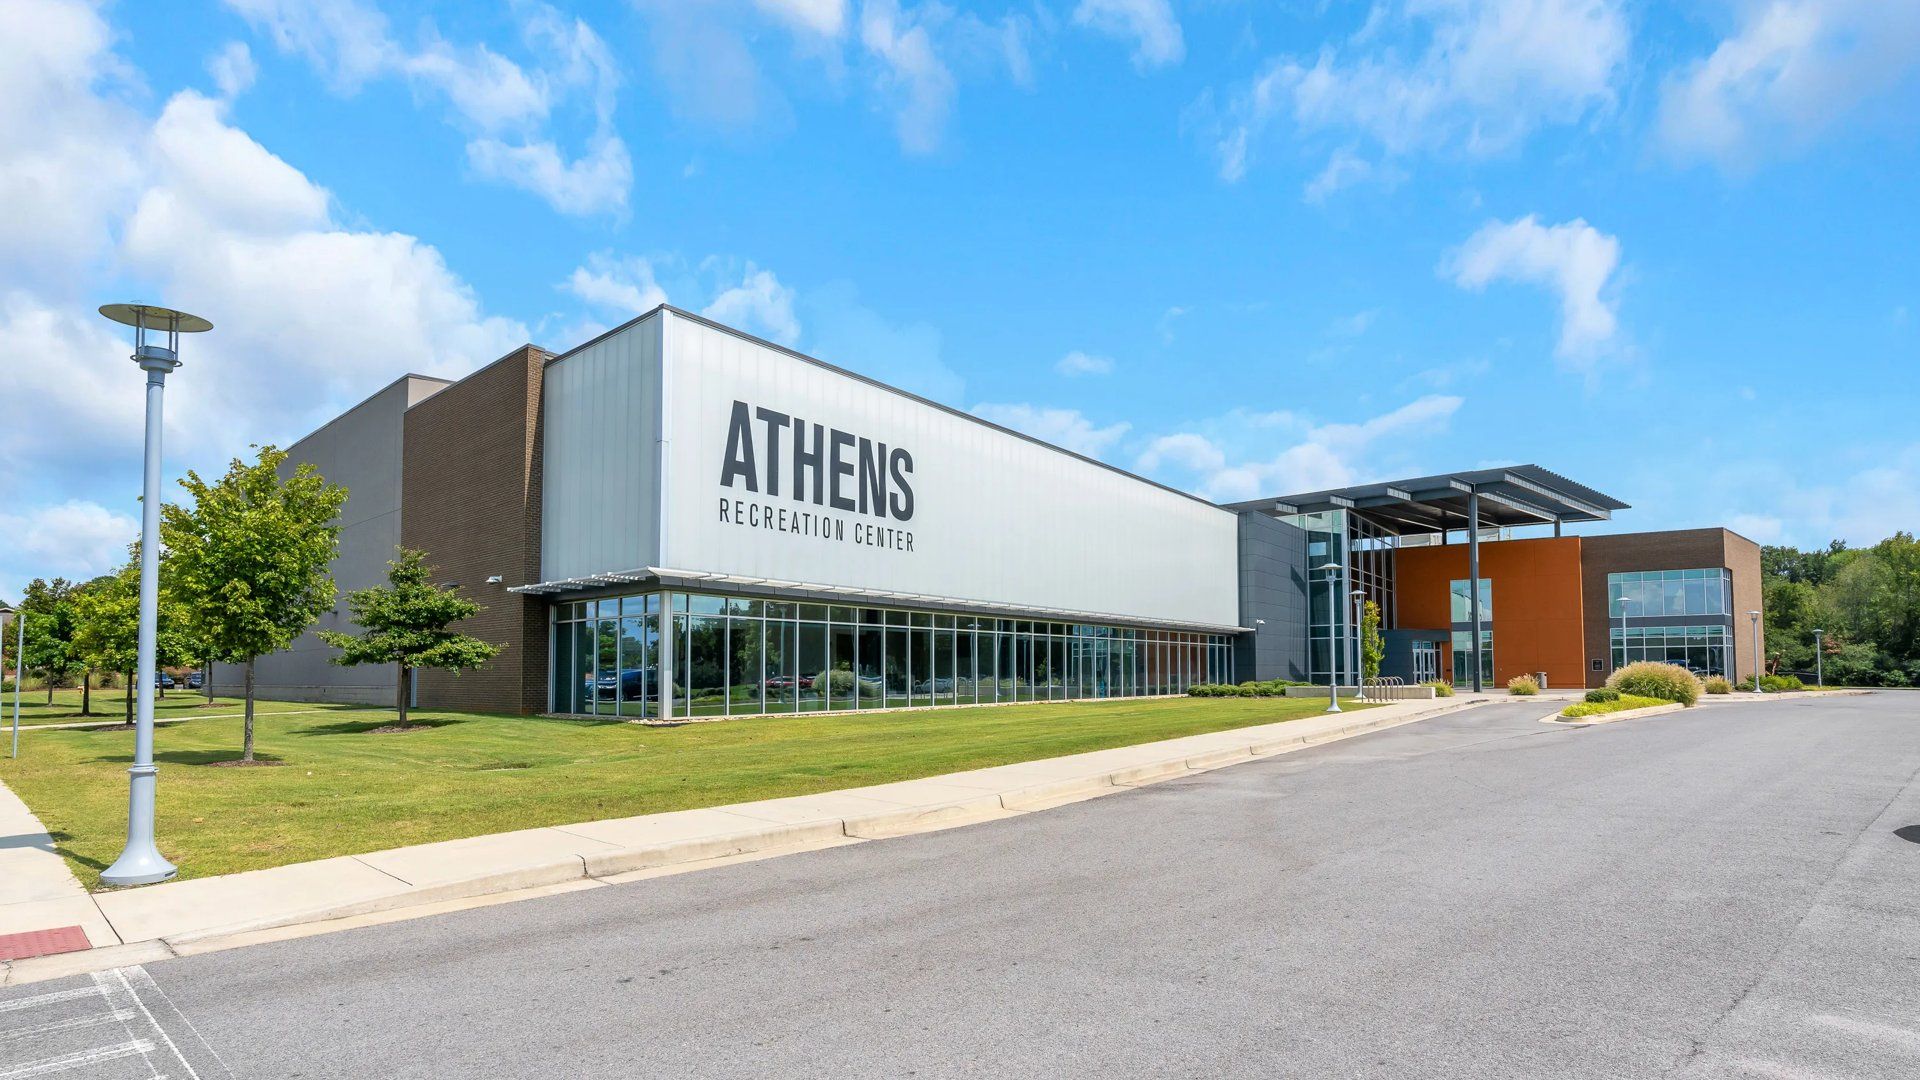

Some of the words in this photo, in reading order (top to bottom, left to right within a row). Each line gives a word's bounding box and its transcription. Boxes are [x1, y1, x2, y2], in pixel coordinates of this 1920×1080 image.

[720, 400, 914, 521] ATHENS
[719, 497, 843, 541] RECREATION
[855, 523, 914, 552] CENTER
